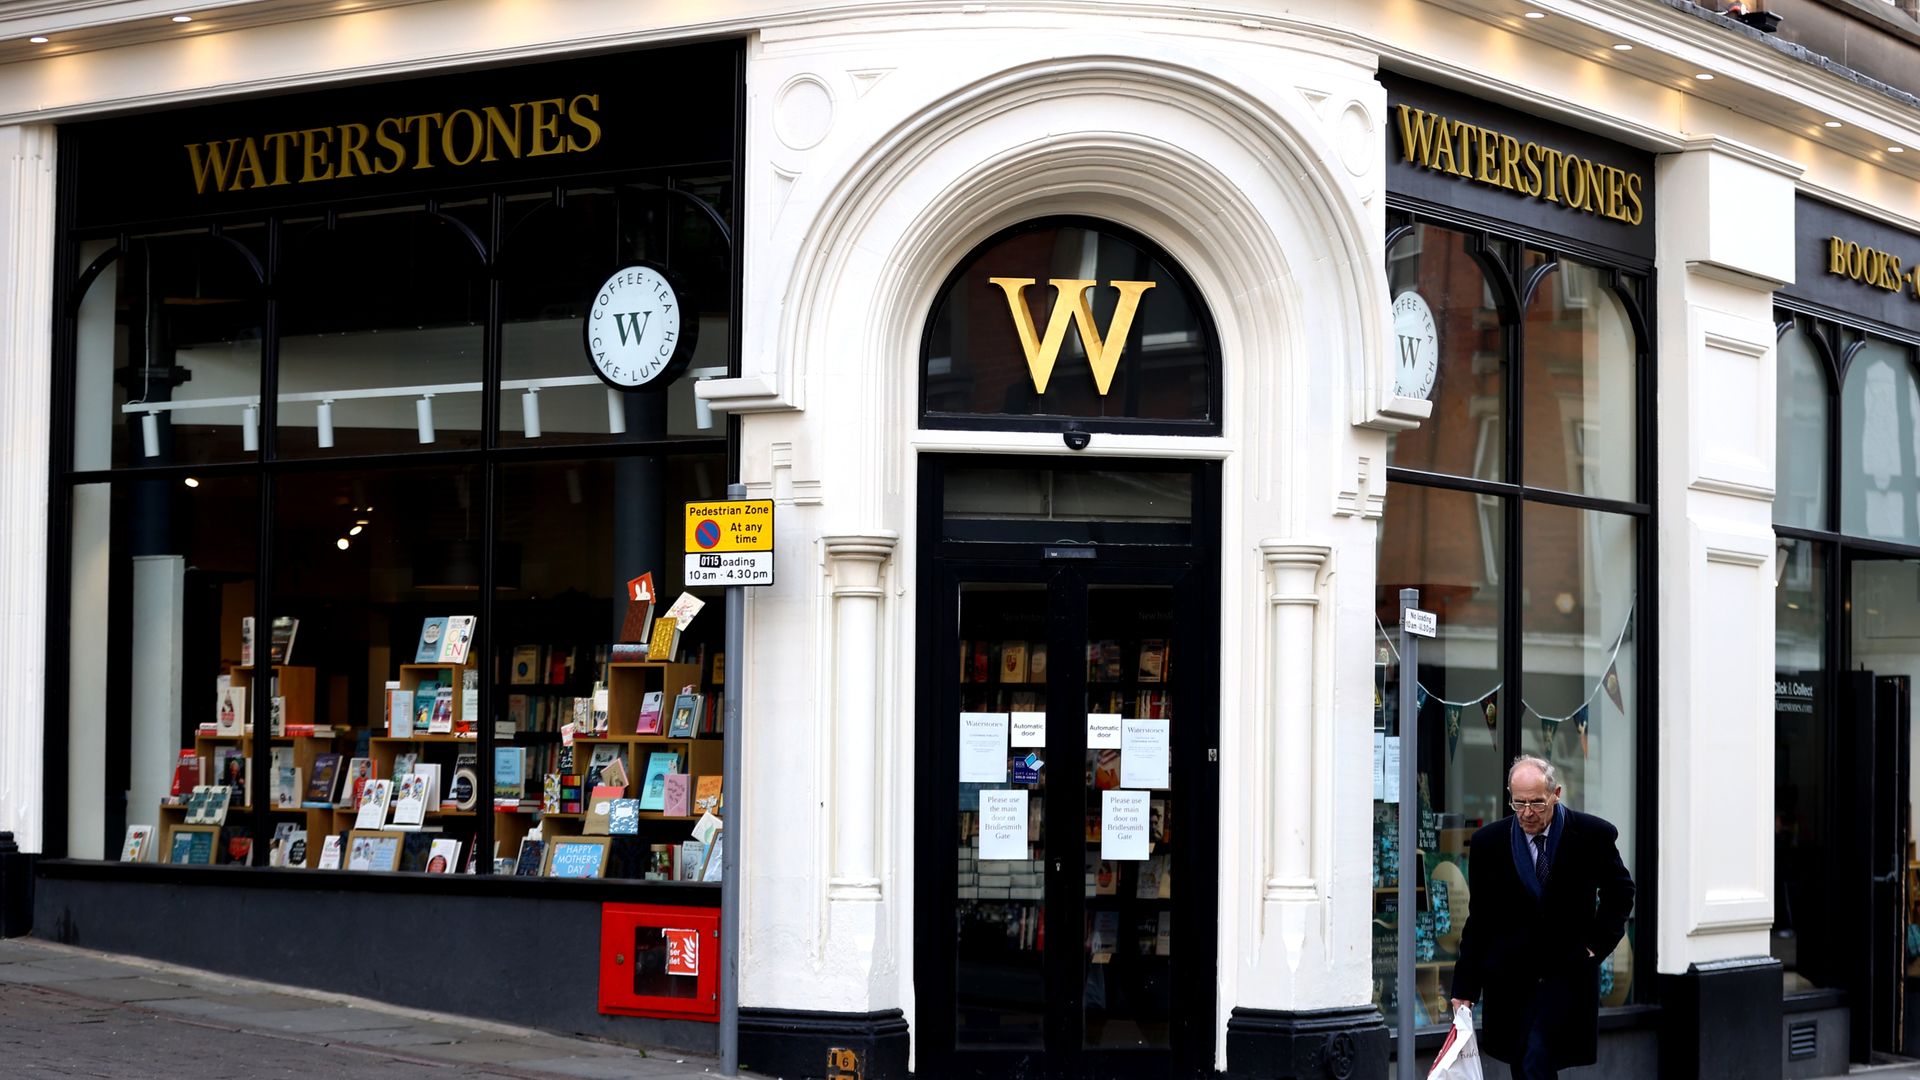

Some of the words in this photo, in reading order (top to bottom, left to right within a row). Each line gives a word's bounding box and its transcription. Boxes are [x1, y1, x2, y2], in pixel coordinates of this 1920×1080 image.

[184, 94, 601, 194] WATERSTONES
[1397, 103, 1643, 226] WATERSTONES
[1829, 235, 1902, 293] BOOKS
[593, 272, 643, 321] COFFEE
[653, 281, 673, 314] TEA
[1392, 297, 1417, 323] OFFEE
[613, 310, 653, 347] W
[987, 277, 1156, 396] W
[1422, 311, 1434, 345] TEA
[592, 337, 621, 378] CAKE
[631, 330, 675, 382] LUNCH
[1397, 334, 1423, 370] W
[689, 506, 742, 516] Pedestrian
[745, 505, 769, 515] Zone
[730, 522, 742, 532] At
[745, 523, 763, 533] any
[735, 535, 757, 544] time
[700, 555, 721, 568] 0115
[557, 855, 598, 864] MOTHER'S
[566, 844, 593, 854] HAPPY
[567, 864, 584, 874] DAY
[670, 942, 678, 950] ry
[842, 1057, 849, 1068] 6
